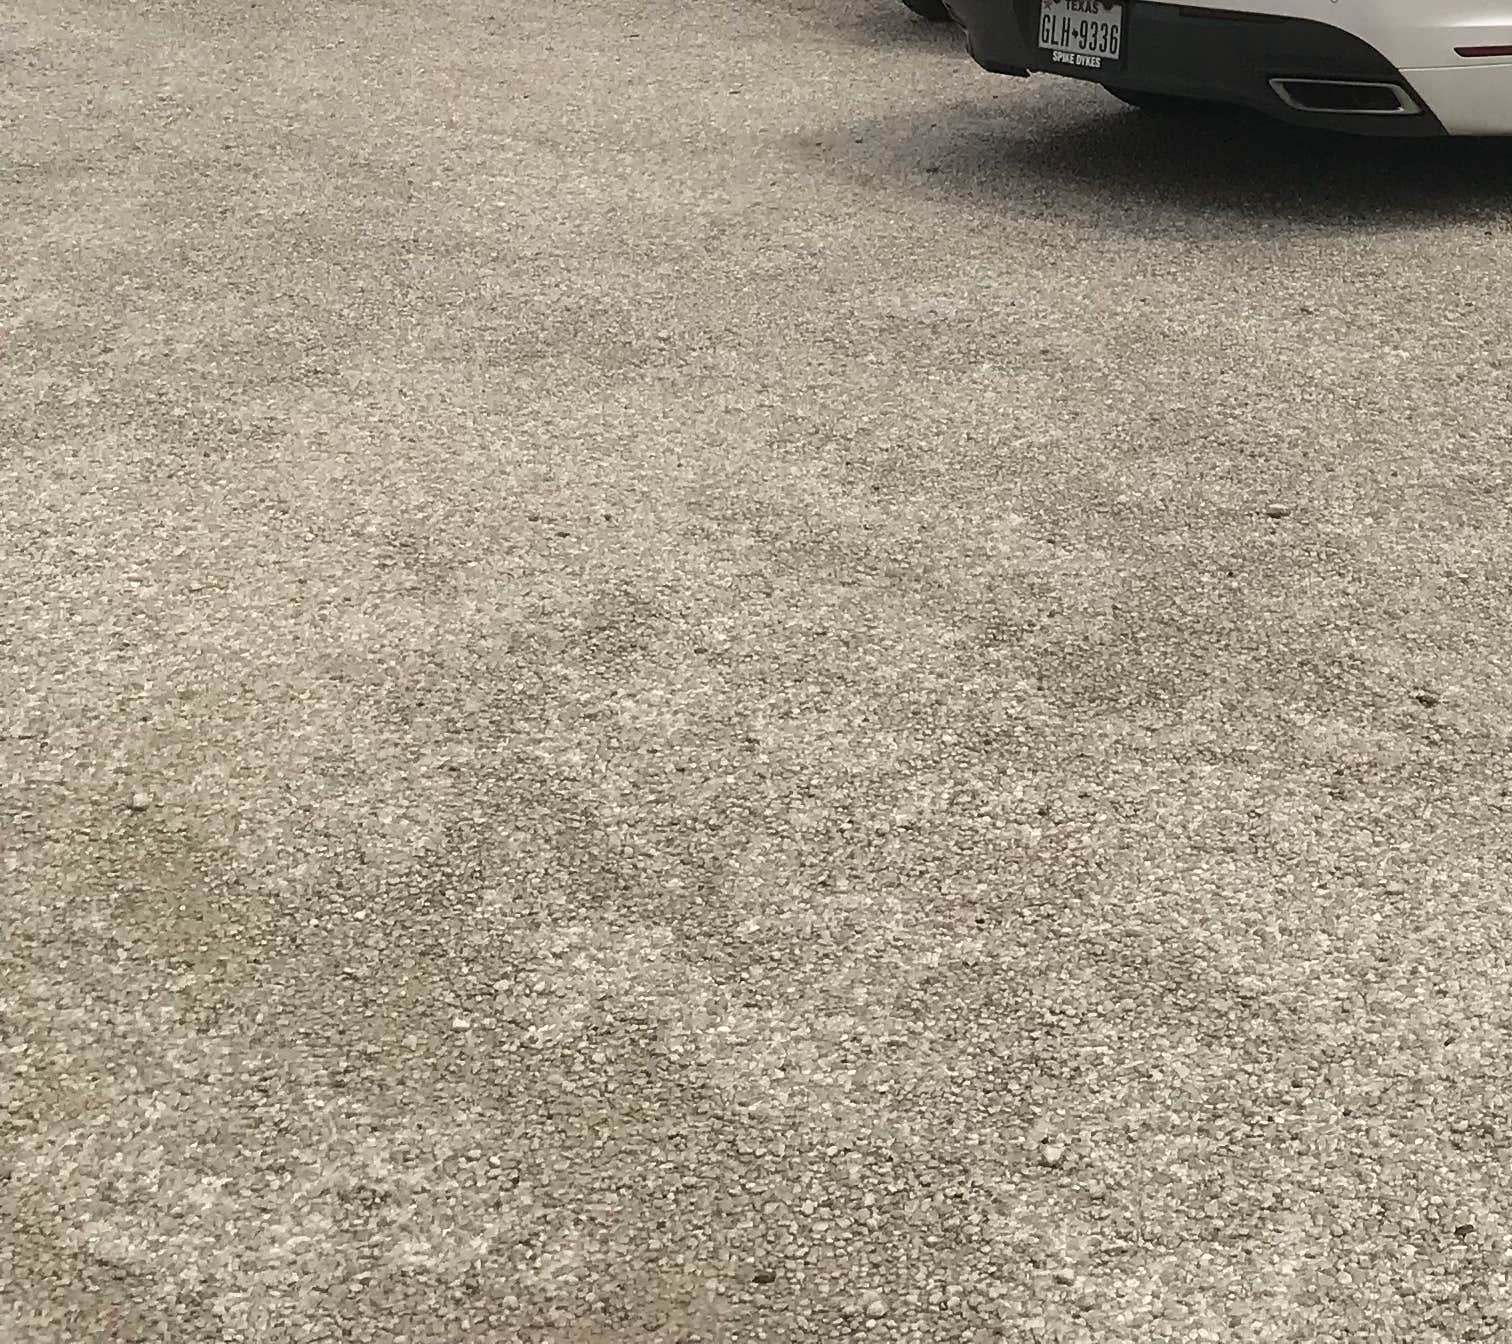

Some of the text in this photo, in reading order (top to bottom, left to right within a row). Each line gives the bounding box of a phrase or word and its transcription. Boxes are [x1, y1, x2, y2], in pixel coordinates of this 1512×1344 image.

[1065, 0, 1099, 14] TEXAS
[1052, 50, 1101, 68] SPIKE DYKES
